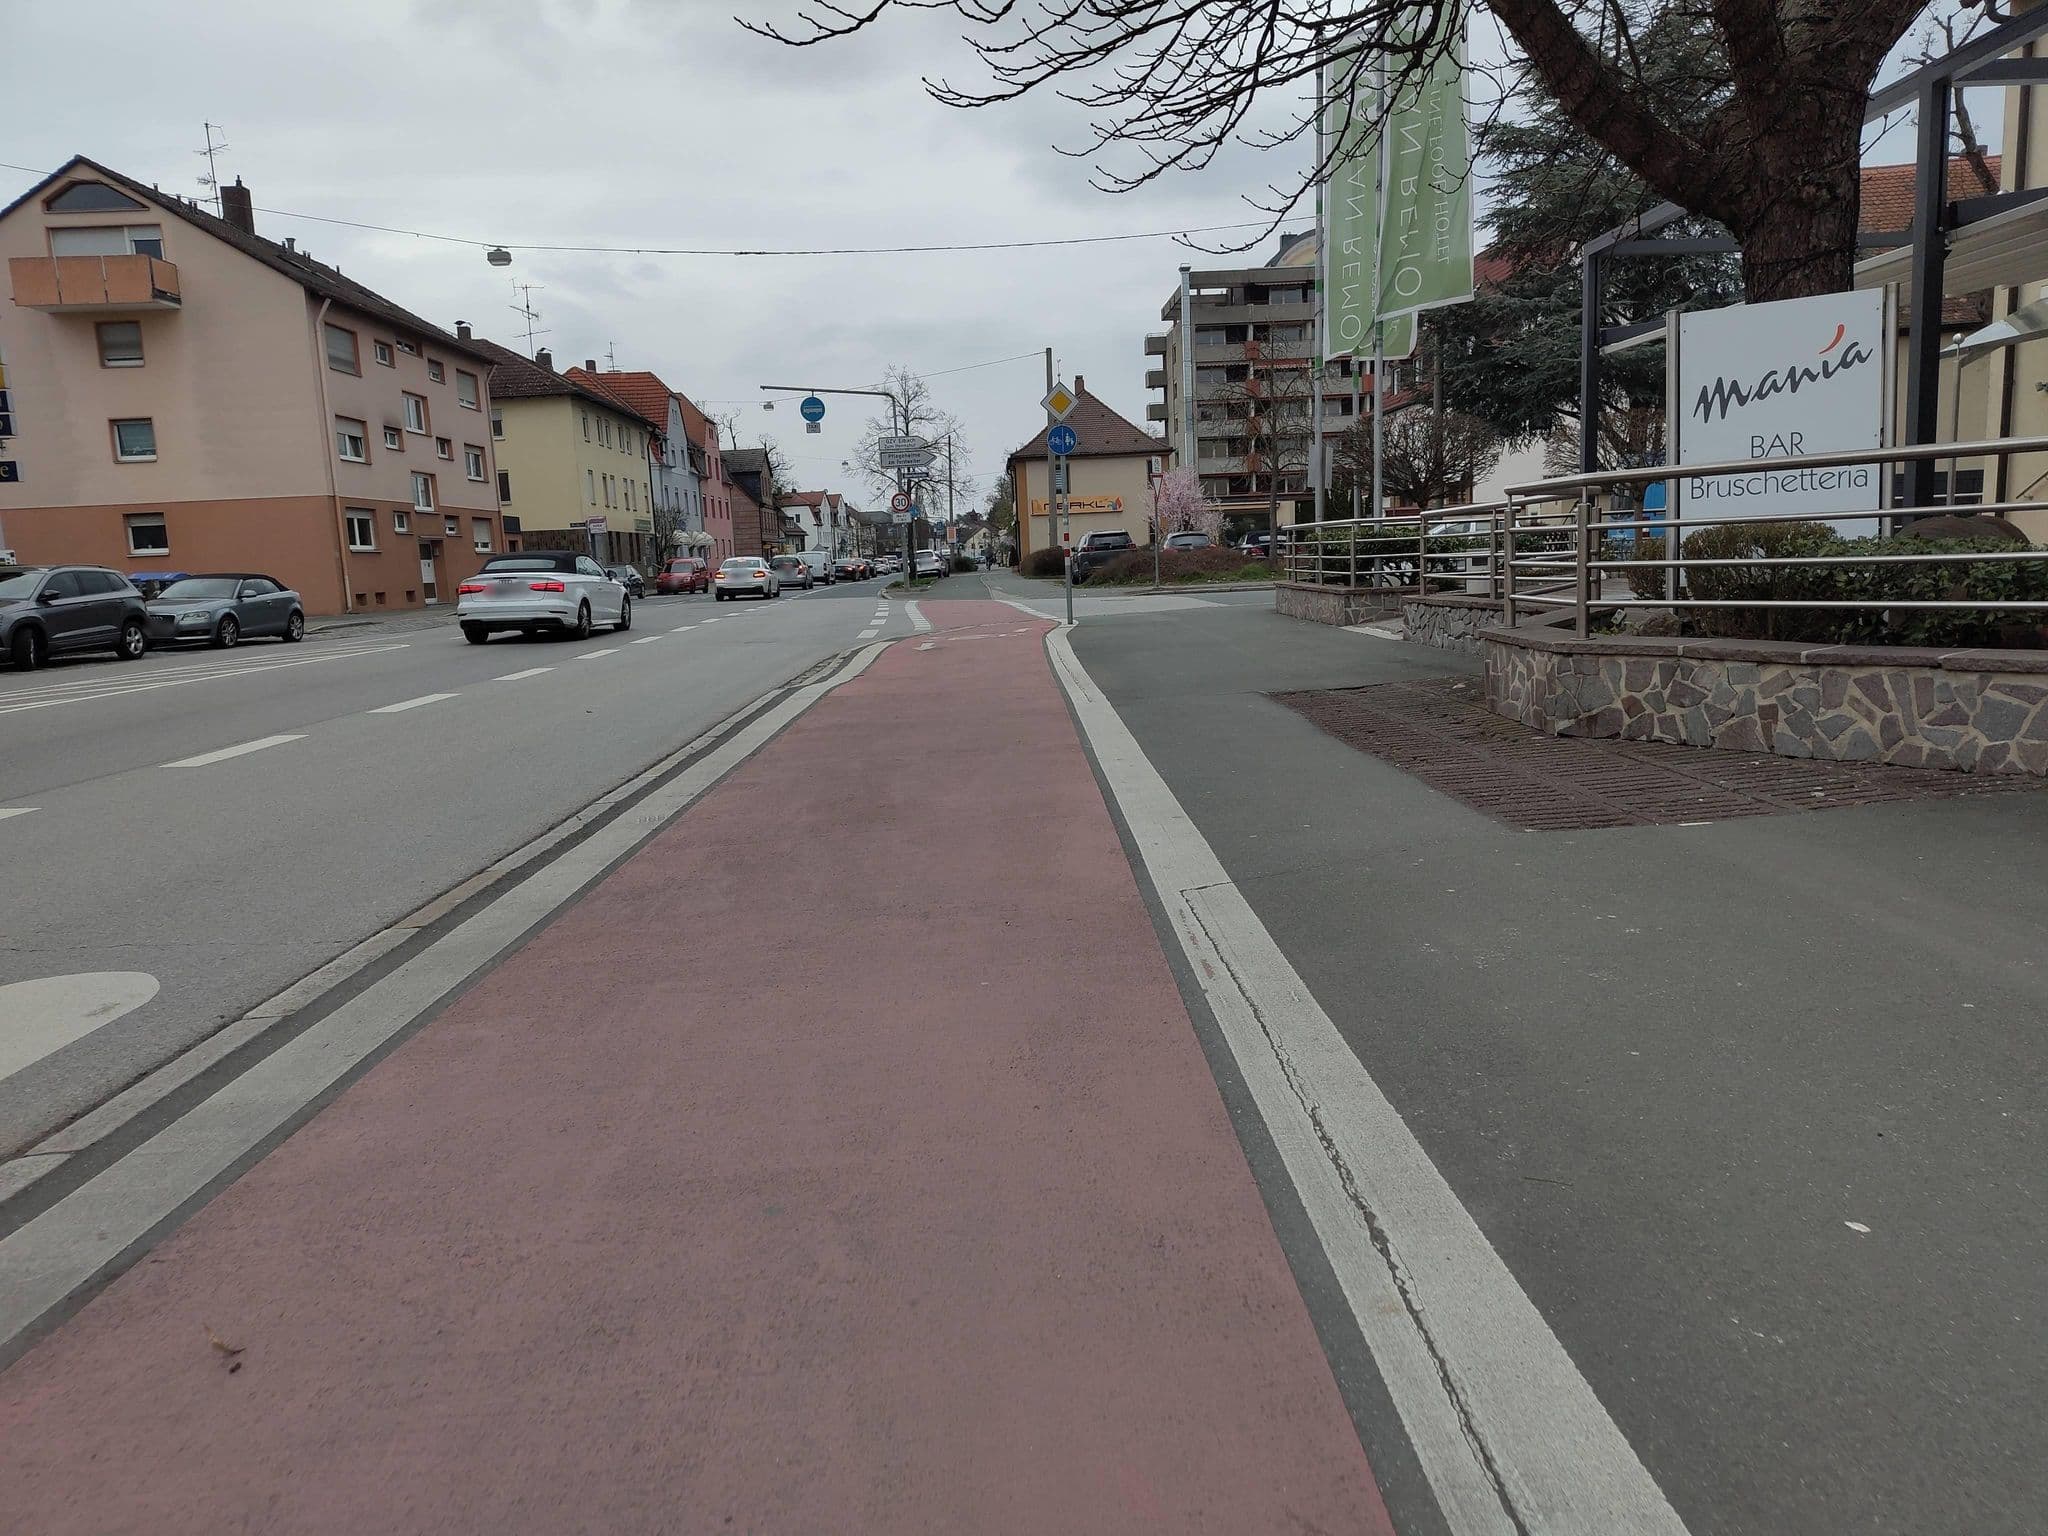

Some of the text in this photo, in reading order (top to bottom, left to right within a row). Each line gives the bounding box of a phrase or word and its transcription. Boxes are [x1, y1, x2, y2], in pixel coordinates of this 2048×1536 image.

[1750, 431, 1804, 458] BAR
[1690, 467, 1868, 500] Bruschetteria
[895, 498, 907, 507] 30
